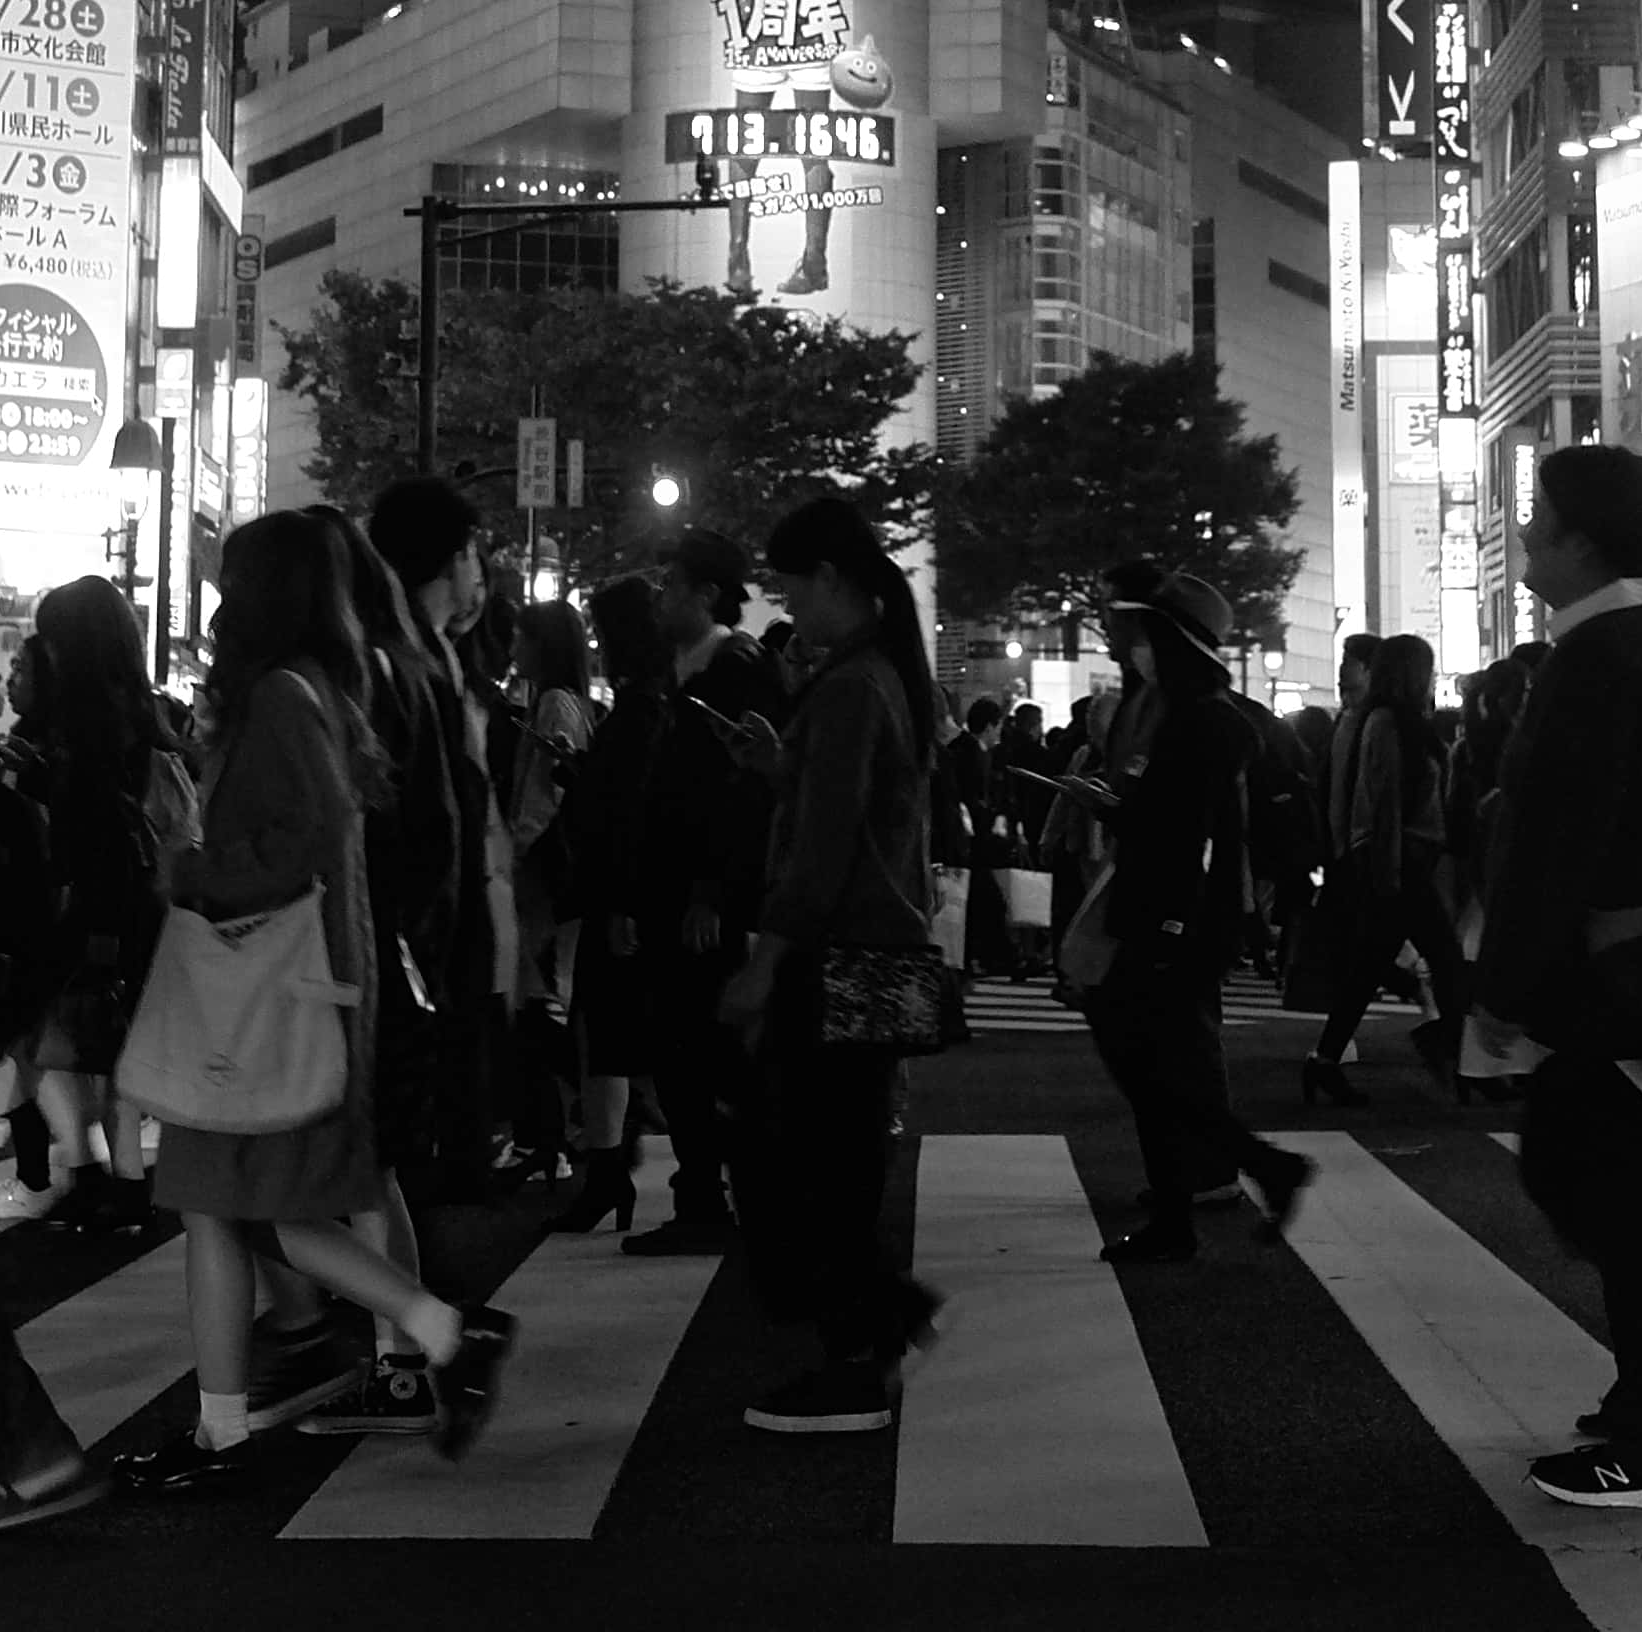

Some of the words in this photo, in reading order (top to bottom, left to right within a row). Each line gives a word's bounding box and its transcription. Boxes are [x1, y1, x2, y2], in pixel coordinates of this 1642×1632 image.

[50, 228, 69, 251] A
[1340, 298, 1355, 411] Matsumoto
[1593, 1462, 1630, 1490] N
